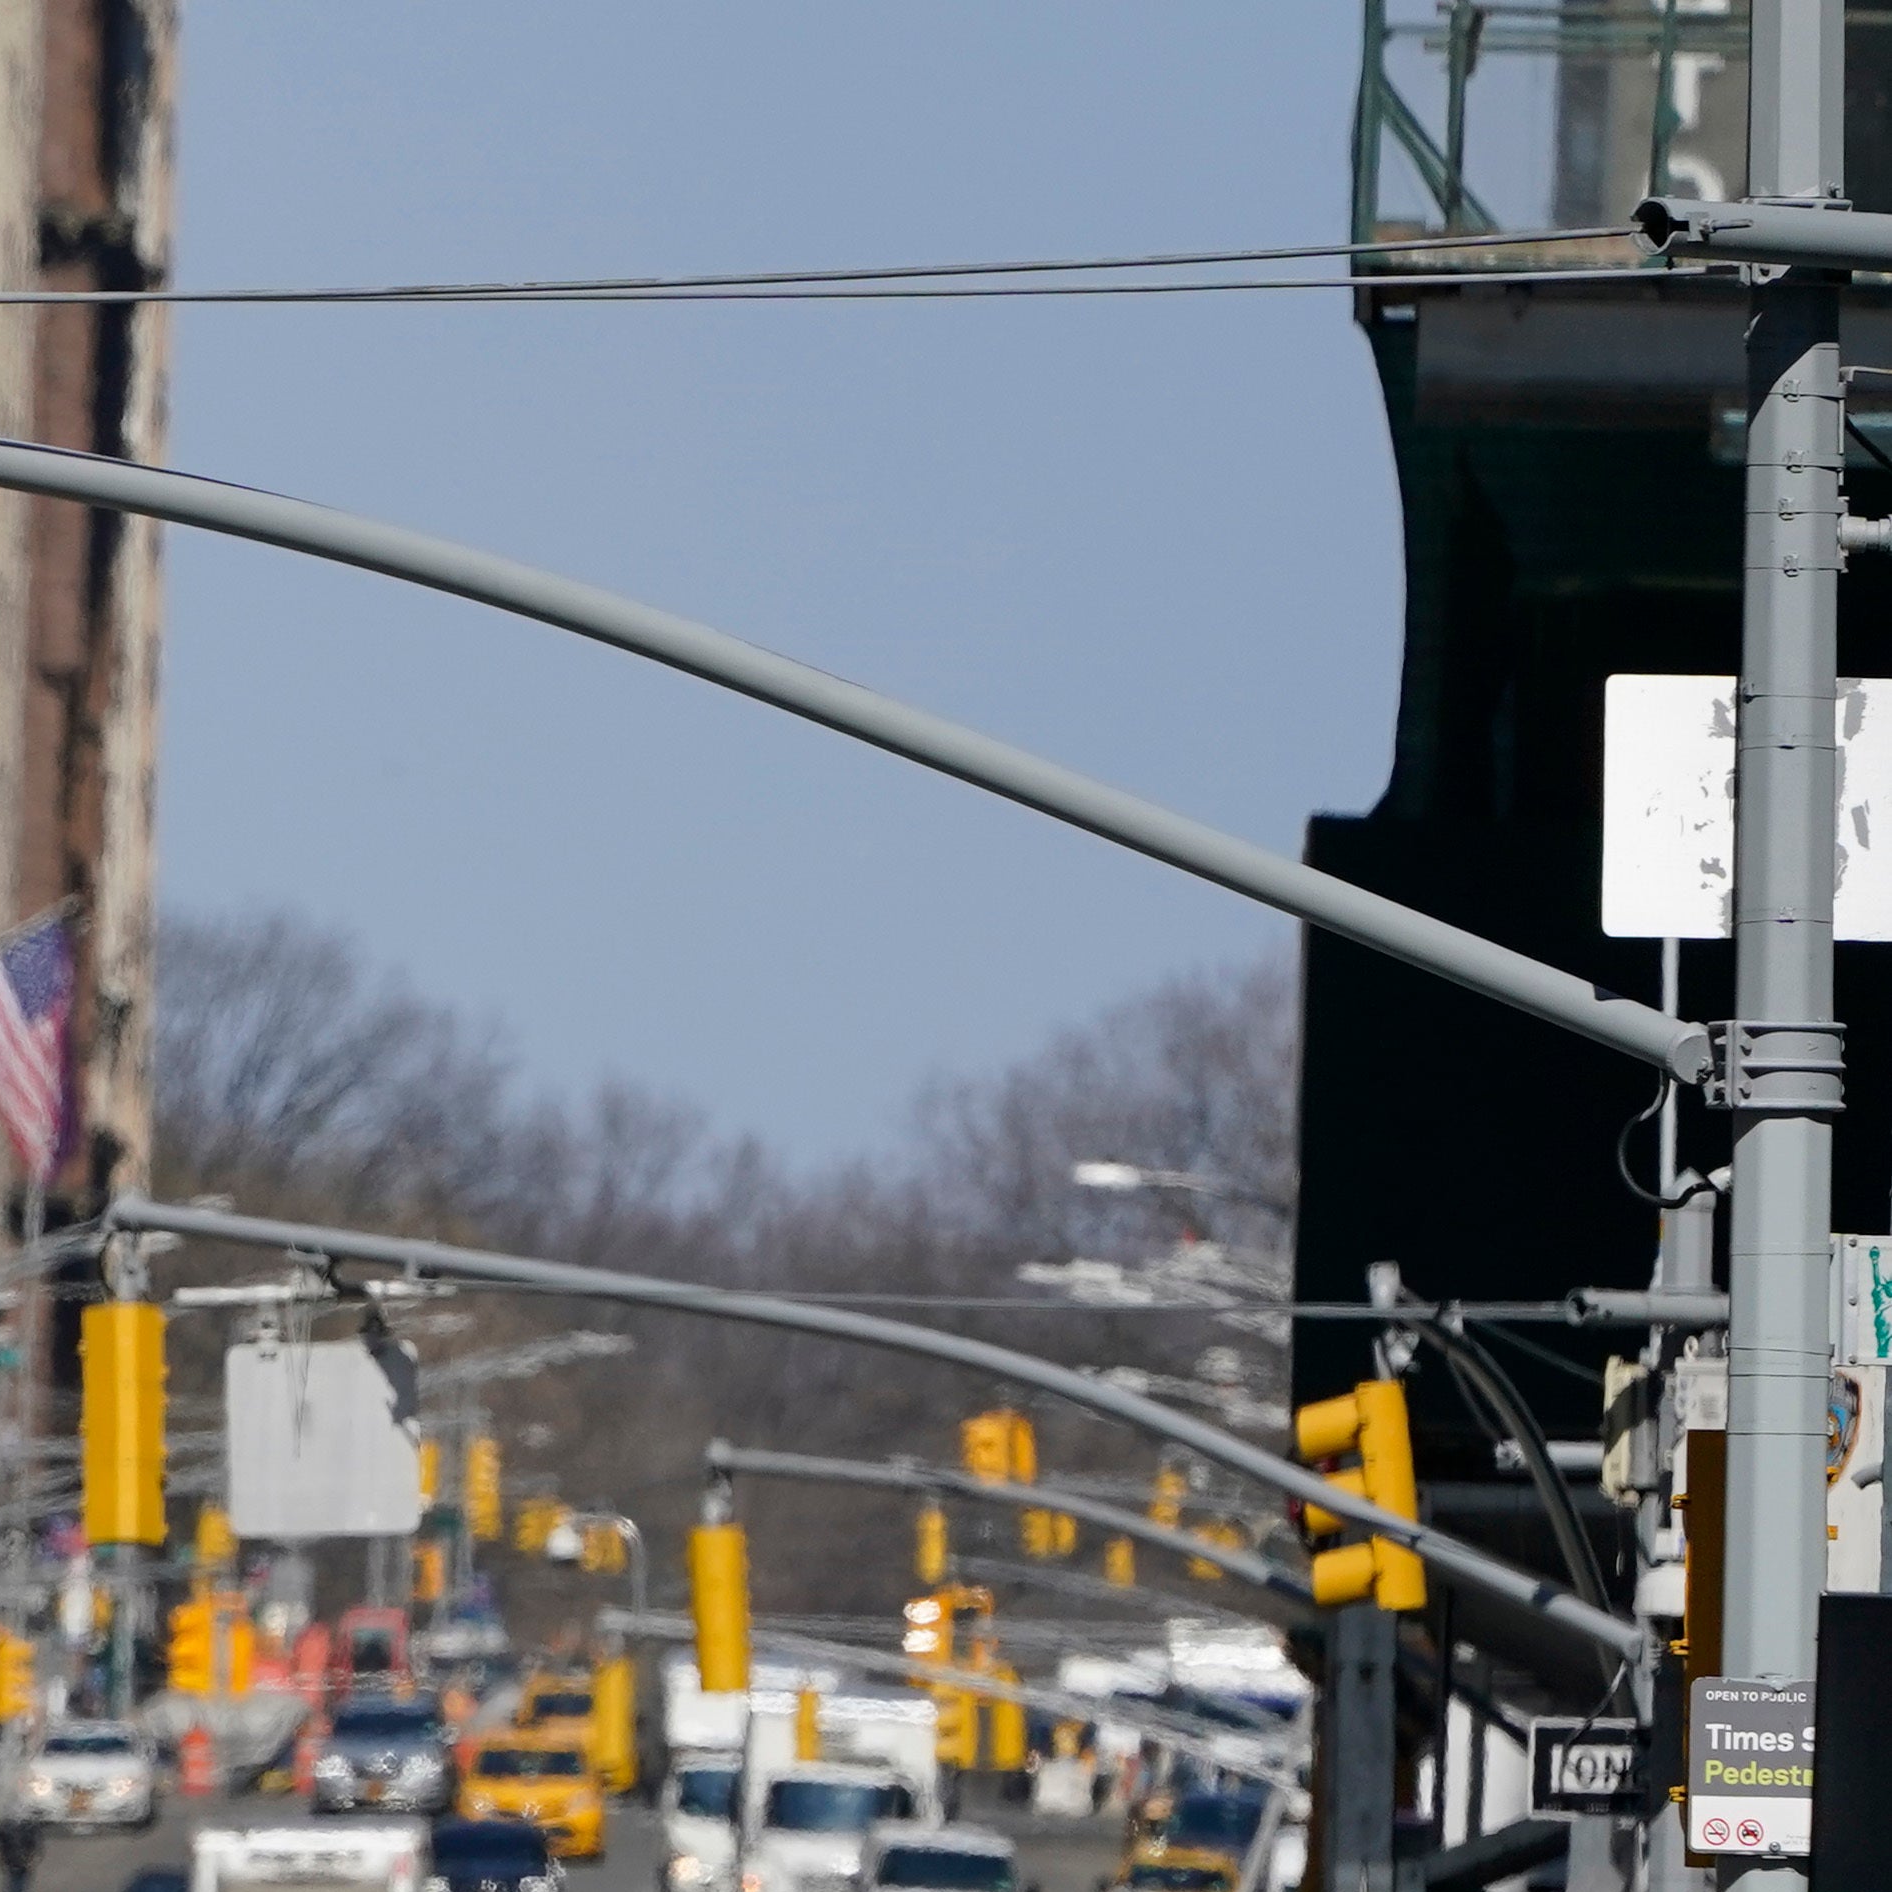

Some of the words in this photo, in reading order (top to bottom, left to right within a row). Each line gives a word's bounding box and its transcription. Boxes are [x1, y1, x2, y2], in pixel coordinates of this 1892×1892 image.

[1705, 1690, 1739, 1701] OPEN
[1742, 1691, 1759, 1702] TO
[1761, 1691, 1807, 1703] PUBLIC
[1705, 1723, 1794, 1752] Times
[1575, 1755, 1629, 1787] ON
[1704, 1759, 1813, 1787] Pedestr
